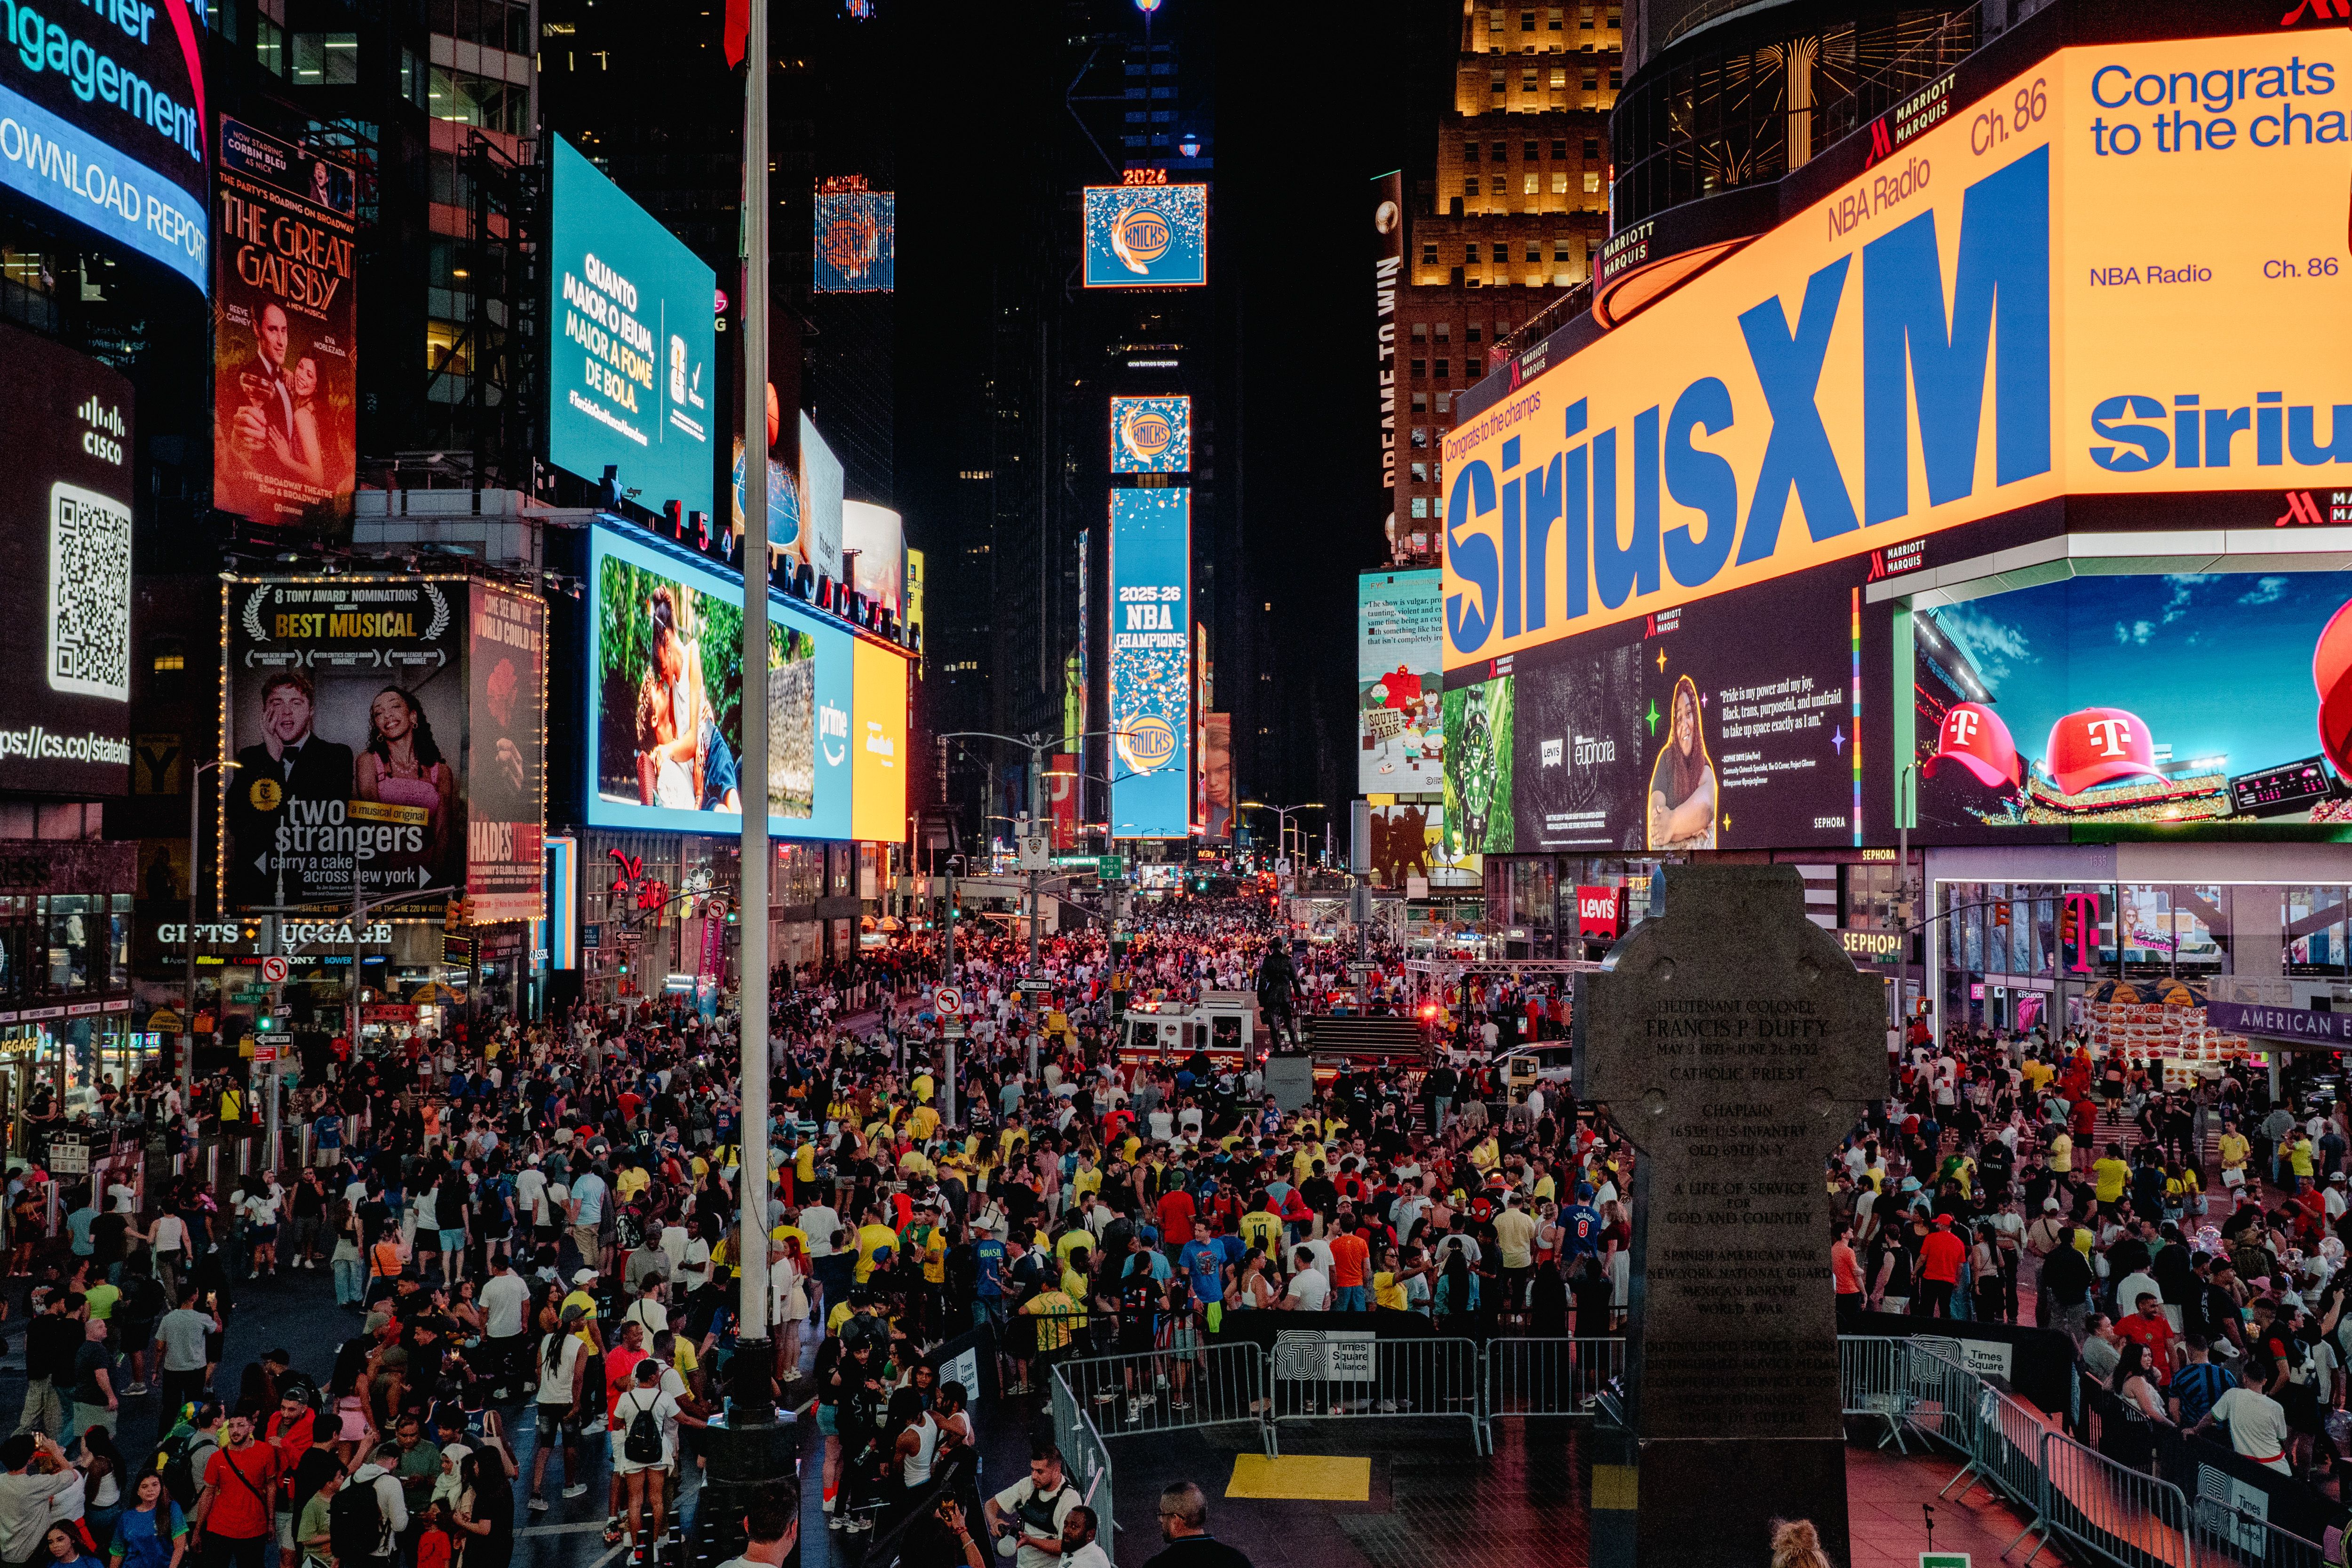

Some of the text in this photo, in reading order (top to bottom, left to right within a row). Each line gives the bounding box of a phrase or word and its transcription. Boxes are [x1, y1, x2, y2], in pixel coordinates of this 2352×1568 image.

[2091, 56, 2335, 113] Congrats
[1897, 72, 1956, 122] MARRIOTT
[1896, 95, 1949, 144] MARQUIS
[2090, 103, 2352, 156] to the cha
[228, 138, 286, 170] CORBIN BLEU
[1828, 78, 2046, 242] NBA Radio Ch. 86
[1123, 169, 1167, 184] 2026
[0, 118, 206, 269] OWNLOAD REPORT
[269, 193, 355, 234] ROARING BROADWAY
[224, 192, 355, 279] THE GREAT
[1125, 225, 1165, 246] KNICKS
[1604, 221, 1655, 260] MARRIOTT
[1604, 241, 1647, 280] MARQUIS
[237, 245, 340, 311] GATSBY
[2090, 257, 2338, 286] NBA Radio Ch. 86
[586, 254, 637, 312] QUANTO
[1376, 256, 1401, 318] WIN
[226, 313, 251, 326] CARNEY
[564, 272, 654, 364] MAIOR O JEJUM,
[314, 341, 346, 357] NOBLEZADA
[325, 335, 335, 345] EVA
[565, 310, 652, 390] MAIOR A FOME
[1522, 342, 1548, 366] MARRIOTT
[1523, 358, 1545, 379] MARQUIS
[586, 357, 638, 414] DE BOLA.
[1446, 143, 2050, 655] SiriusXM
[1134, 426, 1167, 442] KNICKS
[1446, 391, 1540, 462] Congrats the champs
[83, 431, 122, 466] CISCO
[1888, 540, 1925, 558] MARRIOTT
[1888, 554, 1921, 573] MARQUIS
[286, 589, 418, 602] TONY NOMINATIONS
[1120, 587, 1181, 601] 2025-26
[1406, 598, 1429, 606] vulgar,
[1126, 605, 1173, 630] NBA
[1658, 608, 1681, 622] MARRIOTT
[275, 613, 417, 637] BEST MUSICAL
[475, 613, 529, 649] WORLD COULD
[1383, 626, 1416, 635] something
[1658, 620, 1679, 633] MARQUIS
[1116, 633, 1184, 649] CHAMPIONS
[1398, 635, 1432, 644] completely
[1497, 655, 1513, 666] MARRIOTT
[1497, 665, 1512, 674] MARQUIS
[1746, 676, 1814, 700] my power and my joy.
[1723, 688, 1842, 721] Black, trans, purposeful, and unafraid
[820, 699, 847, 740] prime
[1369, 711, 1399, 727] SOUTH
[1730, 716, 1794, 738] take up space exactly
[1370, 724, 1400, 739] PARK
[1129, 732, 1170, 752] KNICKS
[1575, 735, 1615, 770] euphoria
[287, 795, 345, 825] two
[1814, 818, 1845, 828] SEPHORA
[275, 821, 422, 860] strangers
[321, 854, 352, 869] cake
[1863, 850, 1895, 860] SEPHORA
[2090, 856, 2107, 867] 1535
[303, 867, 415, 886] across york
[196, 956, 224, 964] Nikon
[1657, 1000, 1815, 1014] LIEUTENANT COLONEL
[1647, 1019, 1830, 1037] FRANCIS DUFFY
[2240, 1010, 2330, 1035] AMERICAN
[1219, 1056, 1233, 1068] 26
[1670, 1067, 1807, 1081] CATHOLIC PRIEST
[1702, 1104, 1773, 1117] CHAPLAIN
[1690, 1183, 1808, 1194] LIFE SERVICE
[1727, 1199, 1750, 1208] FOR
[1742, 1212, 1812, 1223] COUNTRY
[1337, 1342, 1366, 1351] Times
[1971, 1349, 2002, 1361] Times
[1333, 1351, 1369, 1362] Square
[1968, 1359, 2004, 1372] Square
[961, 1361, 974, 1374] Times
[961, 1371, 976, 1385] Square
[2238, 1495, 2262, 1518] Times
